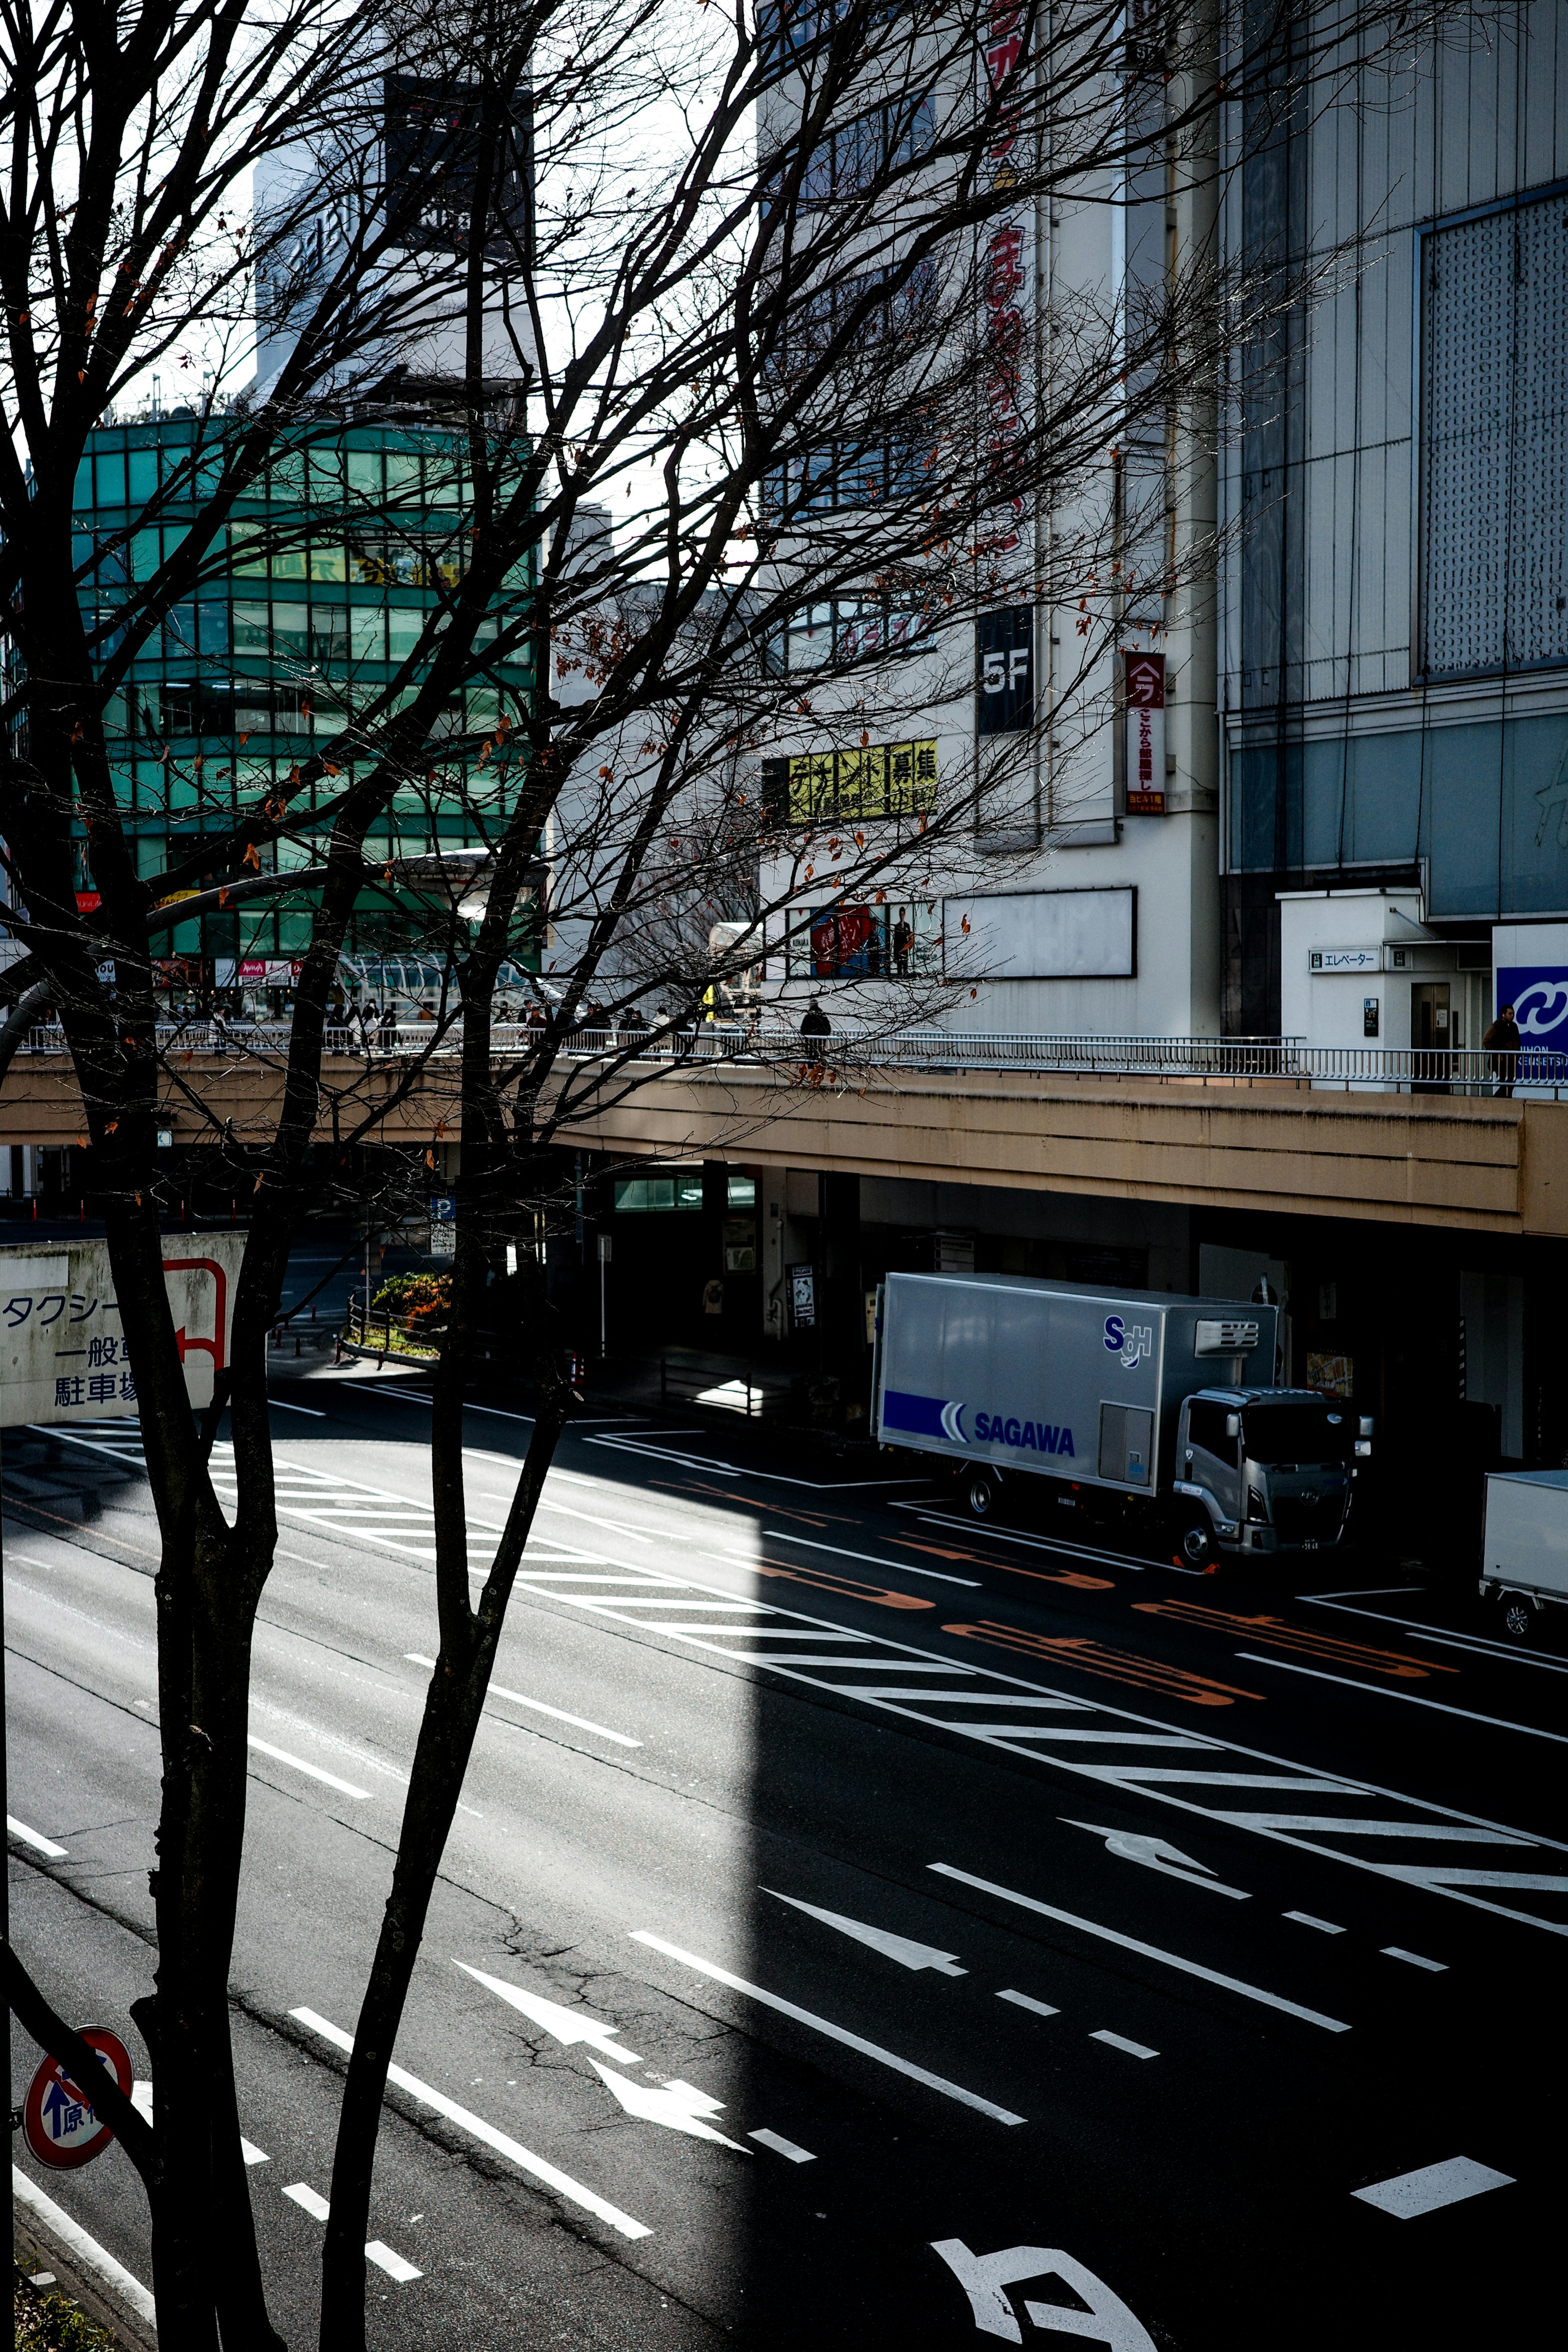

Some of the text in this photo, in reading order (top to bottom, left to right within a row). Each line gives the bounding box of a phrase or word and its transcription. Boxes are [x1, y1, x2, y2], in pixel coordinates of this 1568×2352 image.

[982, 648, 1029, 694] 5F
[790, 748, 936, 795] テナント募集
[1139, 708, 1152, 791] ここから部屋探し
[1325, 953, 1374, 967] エレベーター
[974, 1412, 1075, 1458] SAGAWA
[62, 2101, 96, 2135] 原
